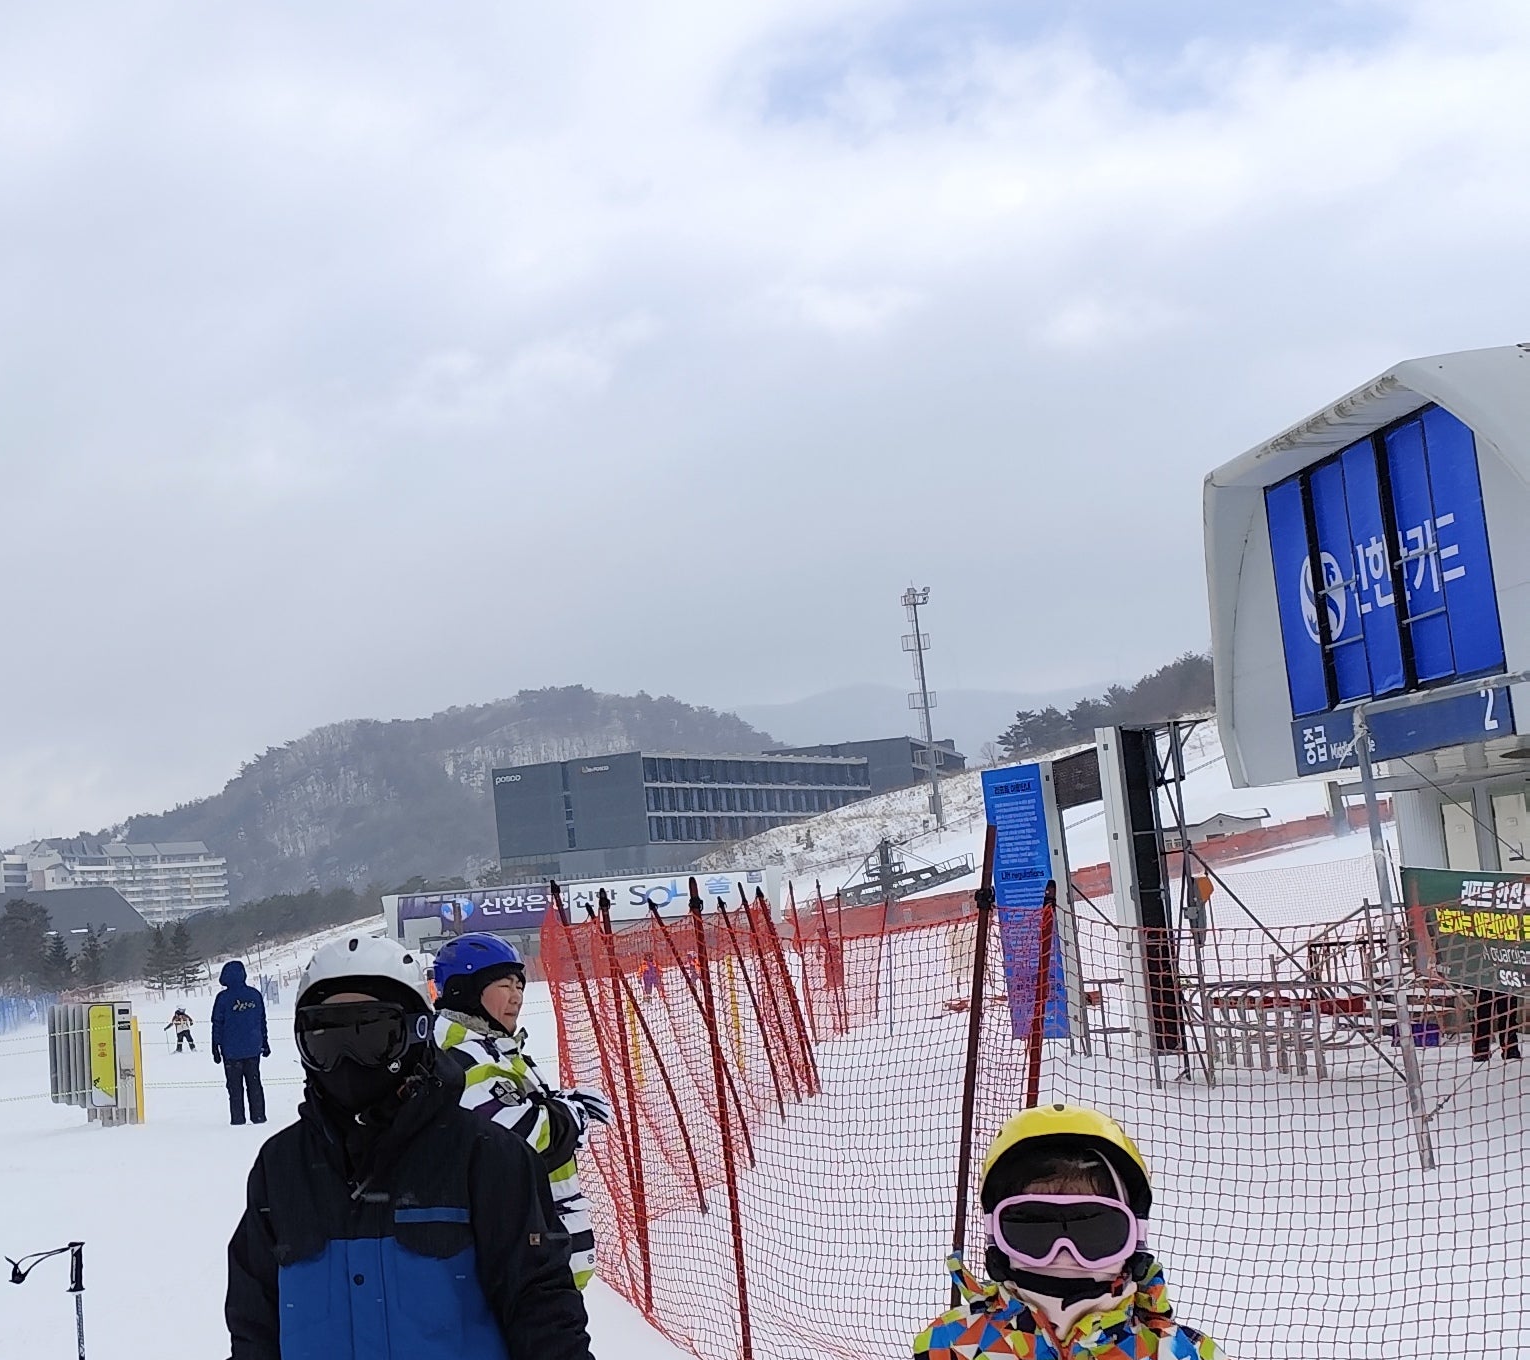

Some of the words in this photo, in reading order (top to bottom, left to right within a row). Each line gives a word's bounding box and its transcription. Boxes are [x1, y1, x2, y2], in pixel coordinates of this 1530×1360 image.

[1480, 688, 1499, 730] 2
[1303, 725, 1328, 765] 중급
[1012, 869, 1045, 881] regulations
[629, 879, 688, 908] SOL
[1461, 880, 1495, 908] 리프트
[1495, 881, 1530, 910] 안전
